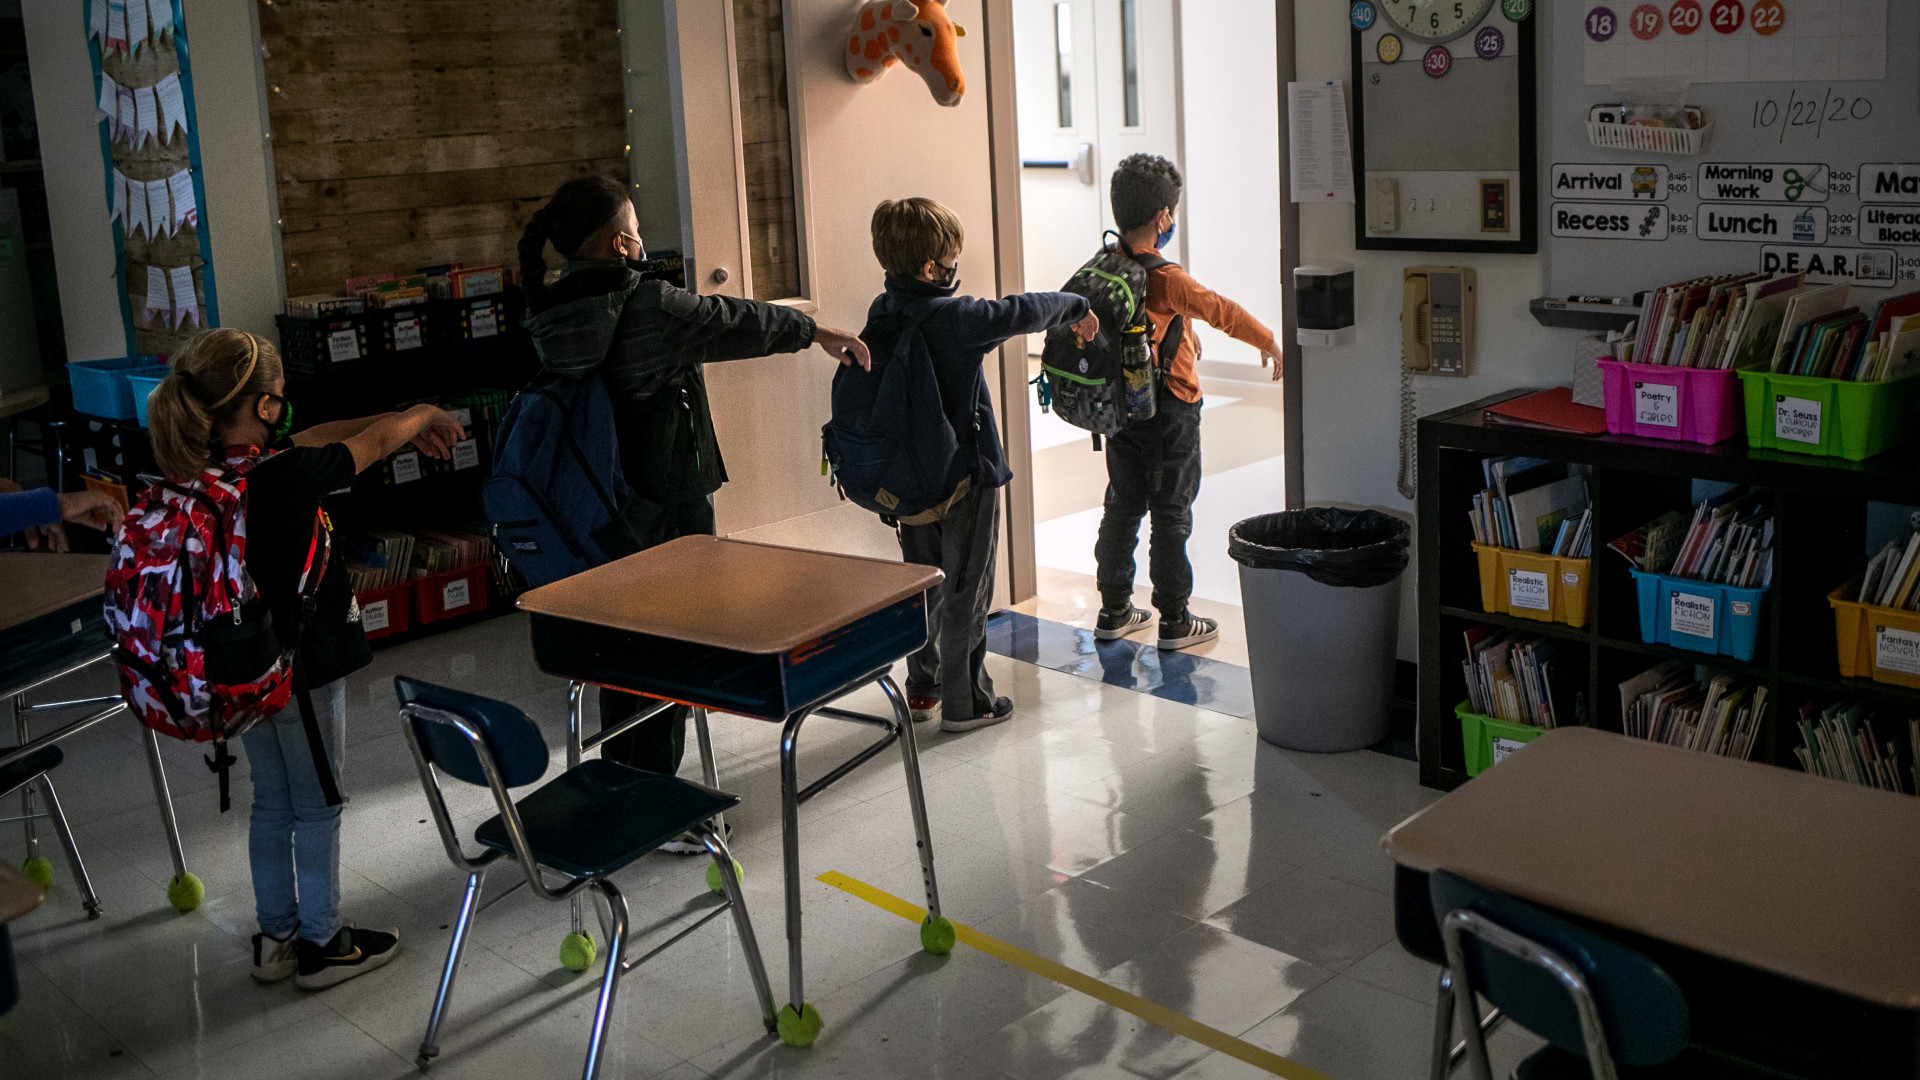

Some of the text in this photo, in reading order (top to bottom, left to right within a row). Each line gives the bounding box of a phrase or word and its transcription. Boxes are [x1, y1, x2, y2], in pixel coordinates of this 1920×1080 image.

[1408, 6, 1416, 22] 7
[1454, 3, 1463, 19] 5
[1430, 13, 1439, 29] 6
[1588, 4, 1781, 35] 18 19 20 21 22
[1479, 35, 1498, 51] :25
[1427, 53, 1446, 70] :30
[1752, 87, 1873, 143] 10/22/20
[1557, 172, 1622, 190] Arrival
[1705, 165, 1773, 183] Morning
[1875, 171, 1920, 193] Ma
[1717, 184, 1760, 198] Work
[1830, 183, 1851, 193] 9:20
[1557, 210, 1630, 232] Recess
[1709, 212, 1777, 235] Lunch
[1795, 224, 1813, 232] MILK
[1829, 226, 1852, 235] 12:25
[1879, 228, 1920, 242] Block
[1641, 391, 1671, 403] Poetry
[1778, 407, 1818, 421] Dr. Seuss
[1512, 575, 1544, 586] Realistic
[1674, 598, 1710, 612] Realistic
[1881, 633, 1920, 649] Fantasy
